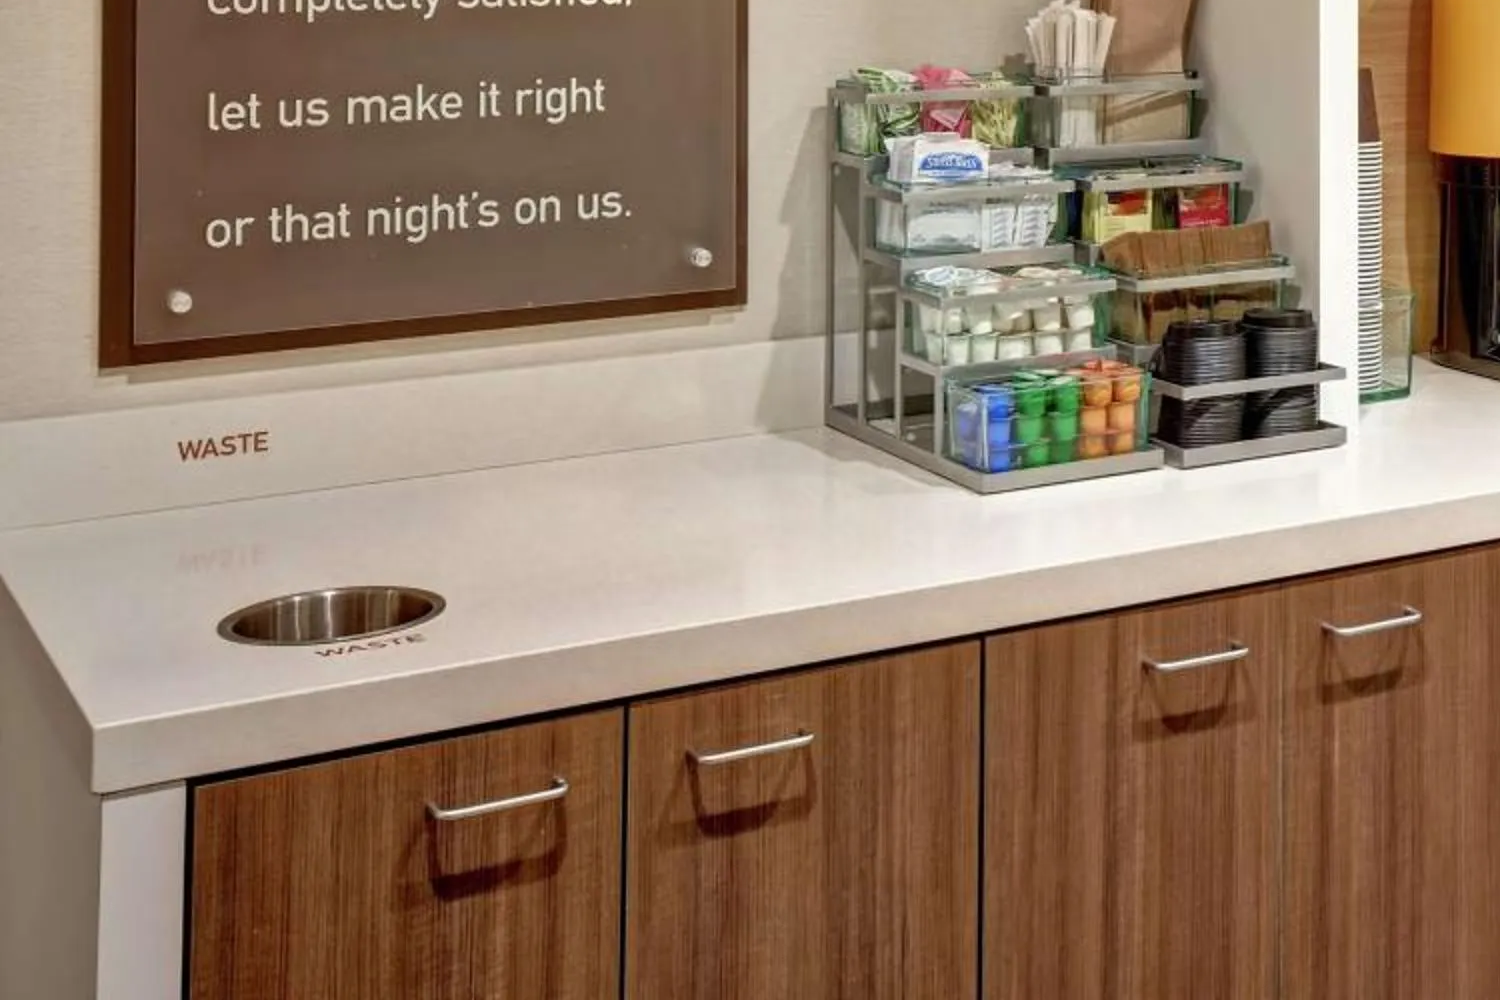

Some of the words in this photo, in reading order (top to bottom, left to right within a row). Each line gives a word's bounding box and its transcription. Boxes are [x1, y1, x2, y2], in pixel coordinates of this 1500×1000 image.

[209, 92, 261, 131] let
[279, 98, 330, 127] us
[347, 83, 463, 125] make
[479, 81, 501, 118] it
[516, 77, 606, 125] right
[206, 217, 255, 249] or
[268, 203, 351, 243] that
[367, 191, 500, 244] night's
[514, 195, 561, 225] on
[577, 191, 632, 220] us.
[178, 431, 269, 463] WASTE
[314, 632, 427, 658] WASTE
